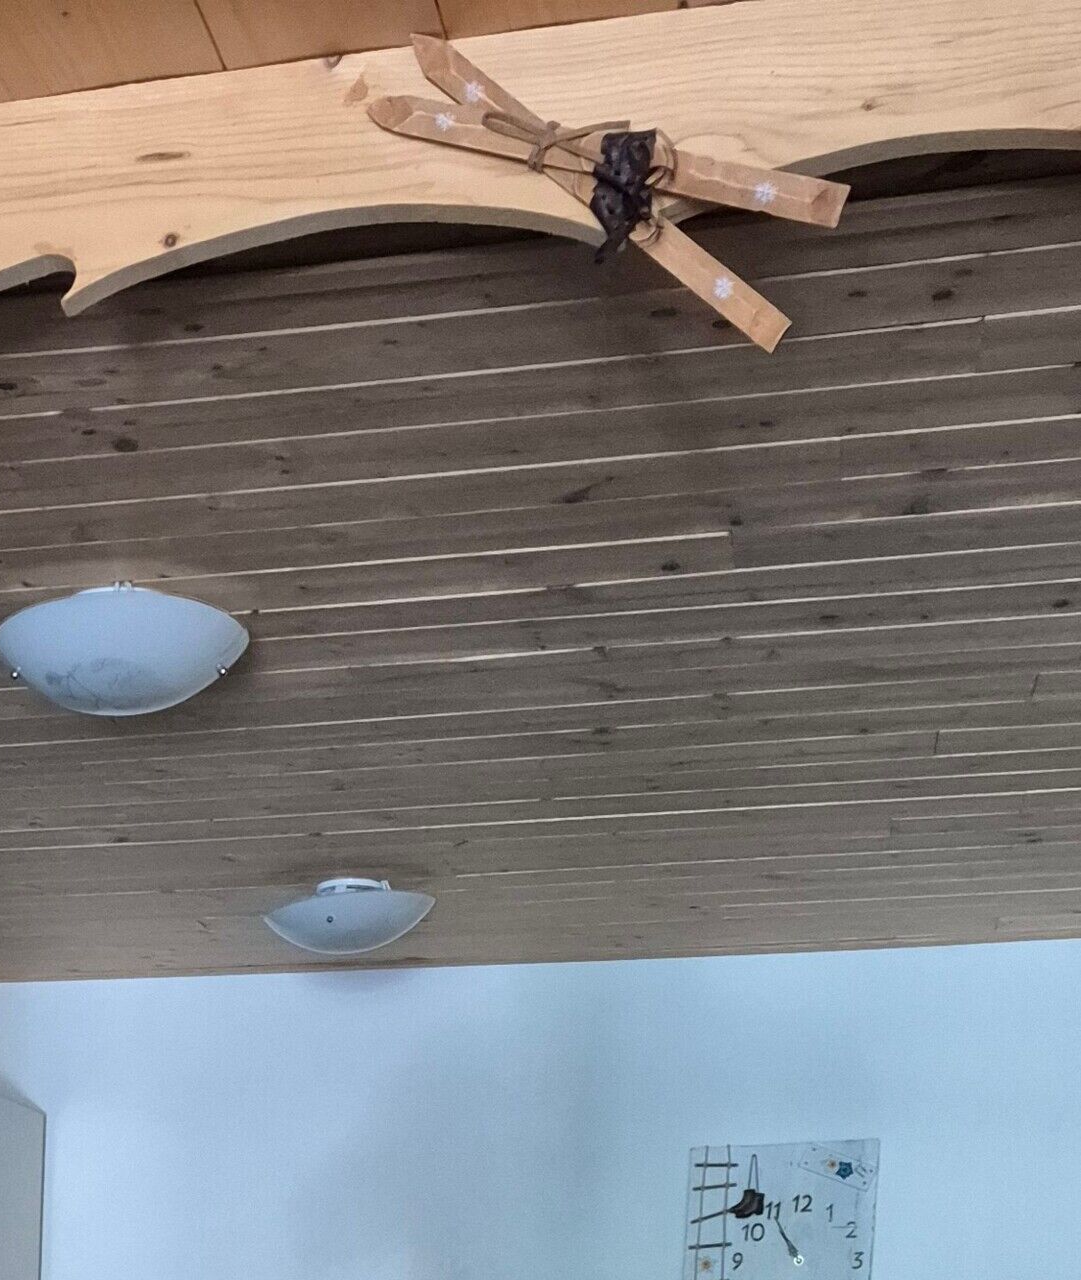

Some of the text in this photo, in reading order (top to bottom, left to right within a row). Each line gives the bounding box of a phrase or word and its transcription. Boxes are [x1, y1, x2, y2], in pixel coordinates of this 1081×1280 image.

[765, 1201, 781, 1220] 11
[792, 1194, 813, 1213] 12
[825, 1204, 834, 1222] 1
[742, 1223, 765, 1241] 10
[845, 1221, 858, 1238] 2
[732, 1252, 743, 1271] 9
[851, 1252, 864, 1269] 3
